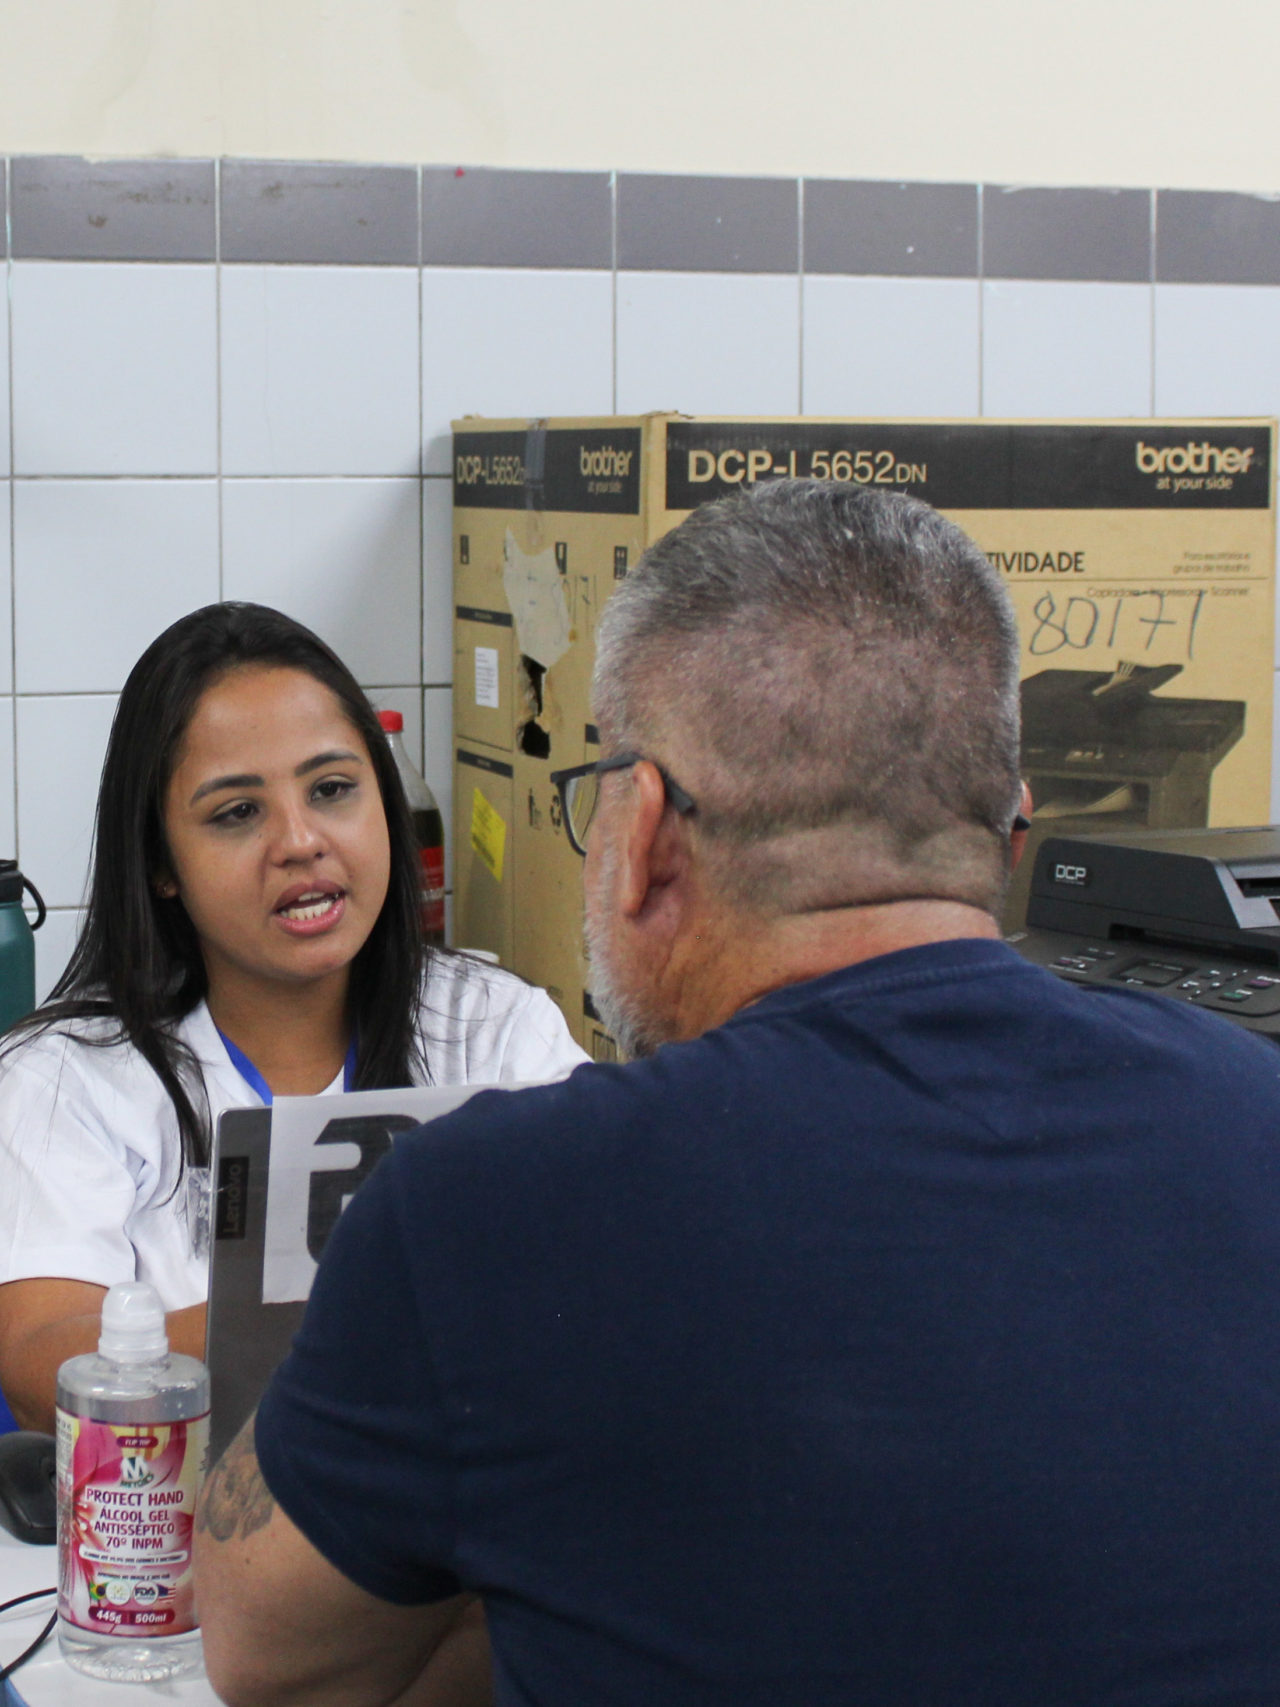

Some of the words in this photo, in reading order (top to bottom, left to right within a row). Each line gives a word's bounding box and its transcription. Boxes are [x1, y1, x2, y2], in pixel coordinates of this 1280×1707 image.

[580, 446, 632, 476] brother
[688, 450, 927, 483] DCP-L5652DN
[1136, 442, 1254, 474] brother
[1156, 477, 1170, 490] at
[1173, 478, 1203, 493] your
[1205, 476, 1233, 490] side
[1029, 590, 1205, 660] 80171
[1056, 864, 1086, 880] DCP
[223, 1164, 241, 1233] Lenovo
[86, 1489, 143, 1506] PROTECT
[148, 1490, 184, 1505] HAND
[100, 1505, 142, 1522] ÁLCOOL
[148, 1509, 170, 1522] GEL
[94, 1520, 175, 1536] ANTISSÉPTICO
[132, 1538, 163, 1550] INPM
[96, 1610, 122, 1624] 445g
[135, 1611, 167, 1624] 500ml
